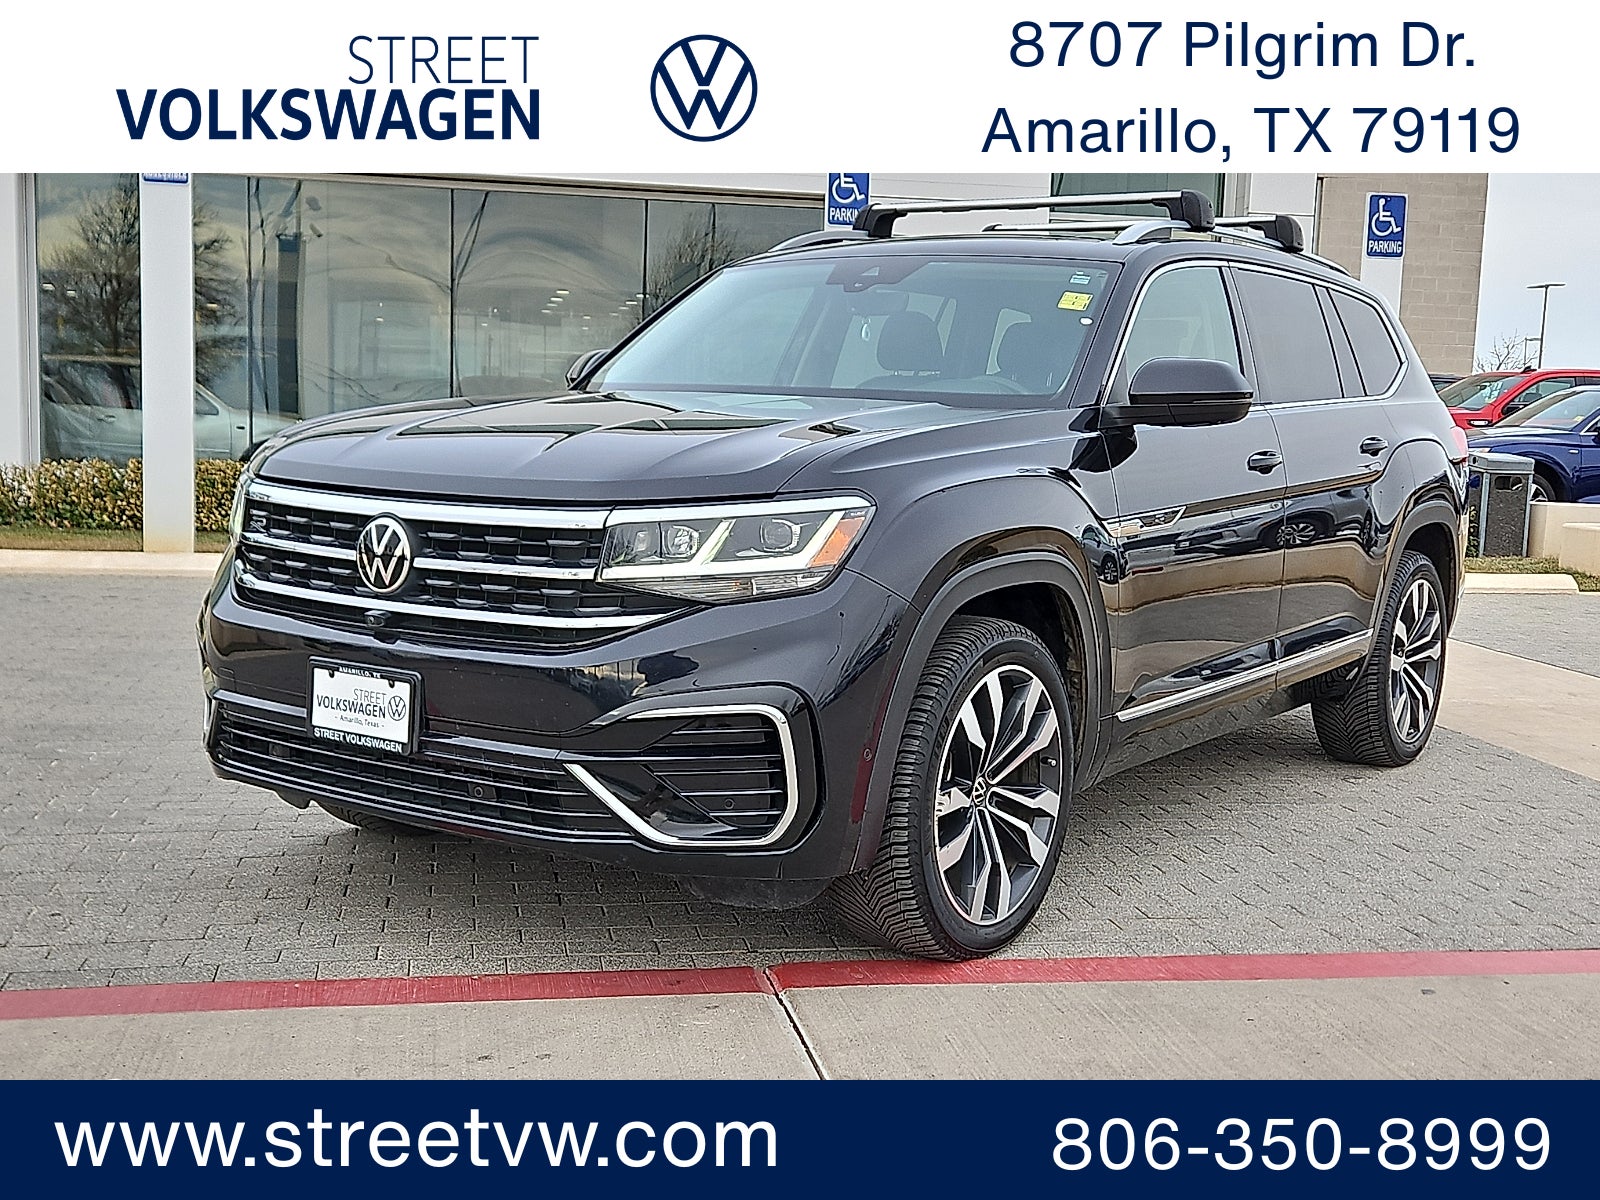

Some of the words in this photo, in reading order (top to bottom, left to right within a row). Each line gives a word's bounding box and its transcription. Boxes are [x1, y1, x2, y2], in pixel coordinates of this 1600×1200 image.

[1368, 240, 1402, 253] PARKING
[353, 688, 387, 705] STREET
[317, 694, 386, 718] VOLKSWAGEN
[339, 714, 363, 726] Amarillo,
[364, 718, 379, 728] Texas
[314, 727, 344, 741] STREET
[344, 732, 402, 753] VOLKSWAGEN
